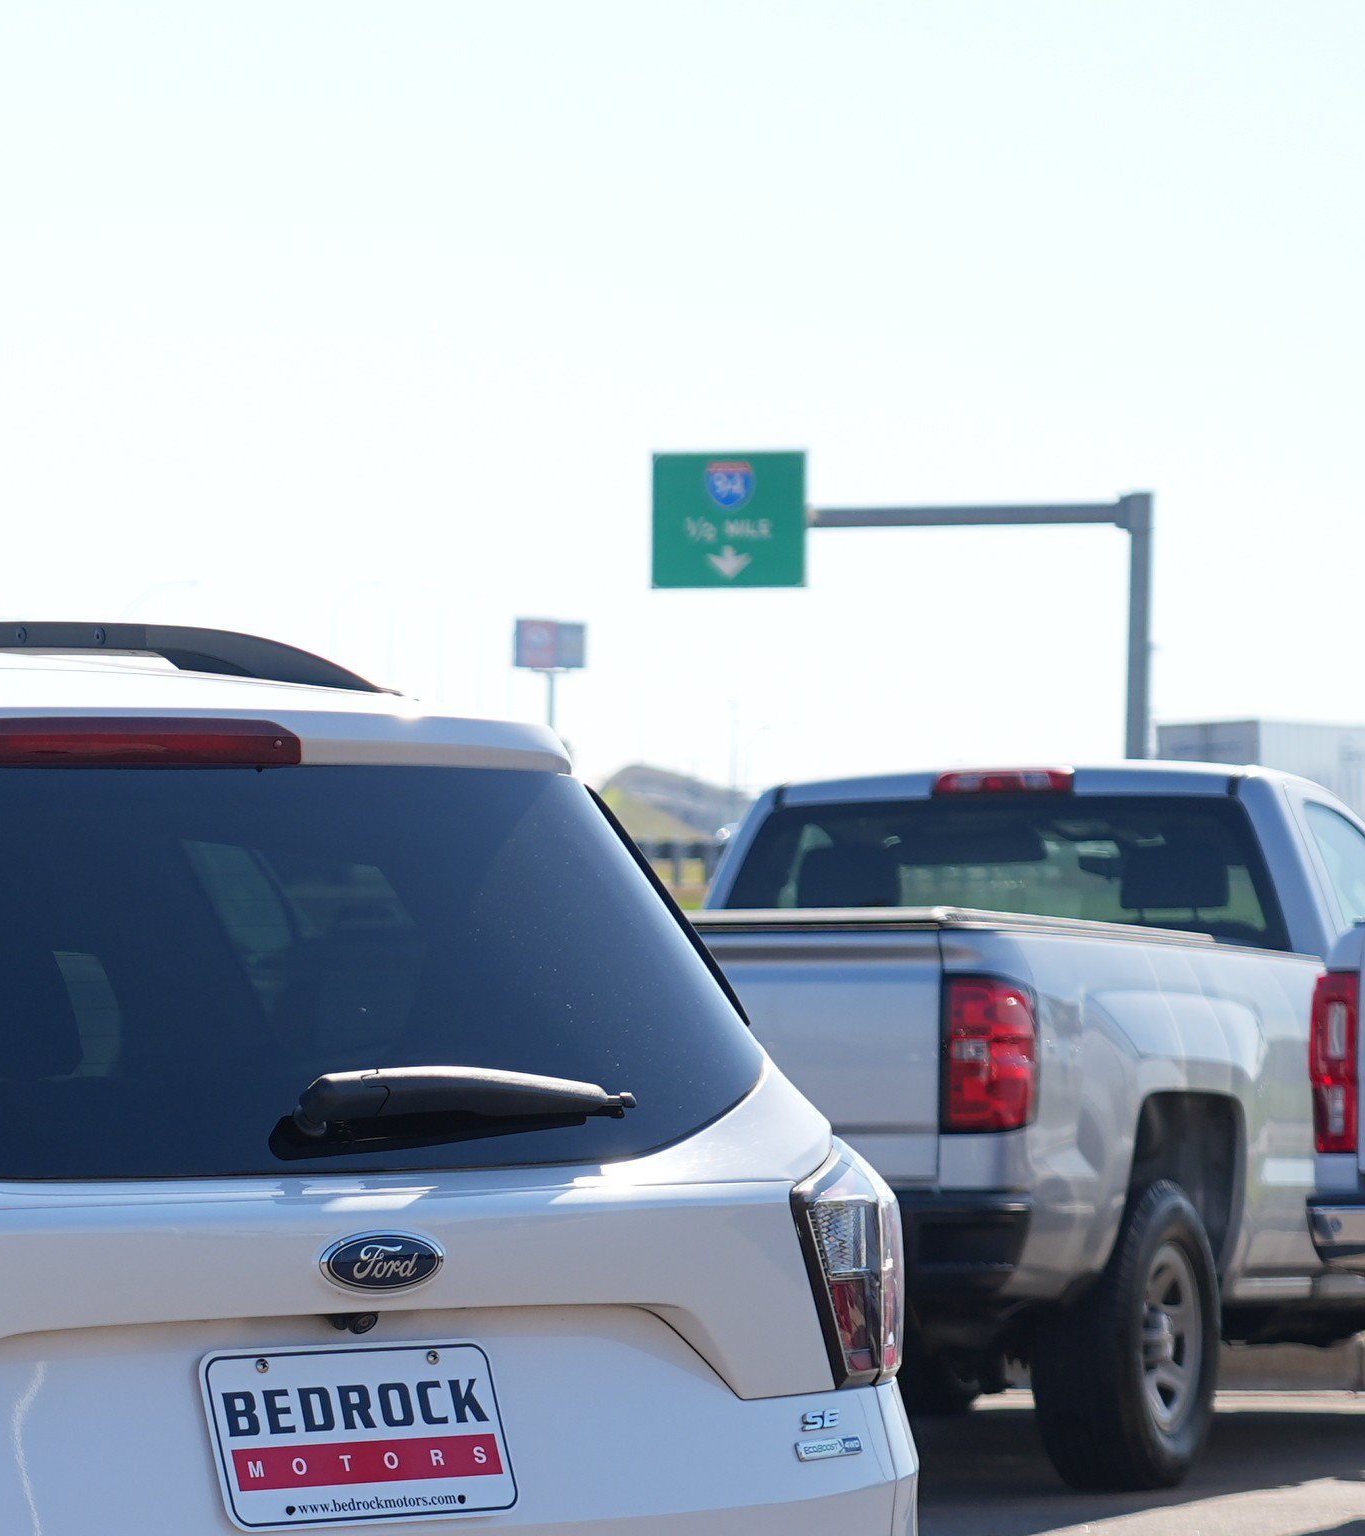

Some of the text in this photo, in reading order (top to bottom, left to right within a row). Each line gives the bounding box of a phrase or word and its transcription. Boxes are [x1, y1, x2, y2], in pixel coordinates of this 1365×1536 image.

[713, 471, 746, 499] 94
[723, 518, 772, 539] MILE
[353, 1244, 418, 1280] Ford
[221, 1378, 490, 1438] BEDROCK
[801, 1408, 840, 1431] SE
[247, 1445, 488, 1479] MOTORS
[298, 1493, 458, 1516] www.bedrockmotors.com
